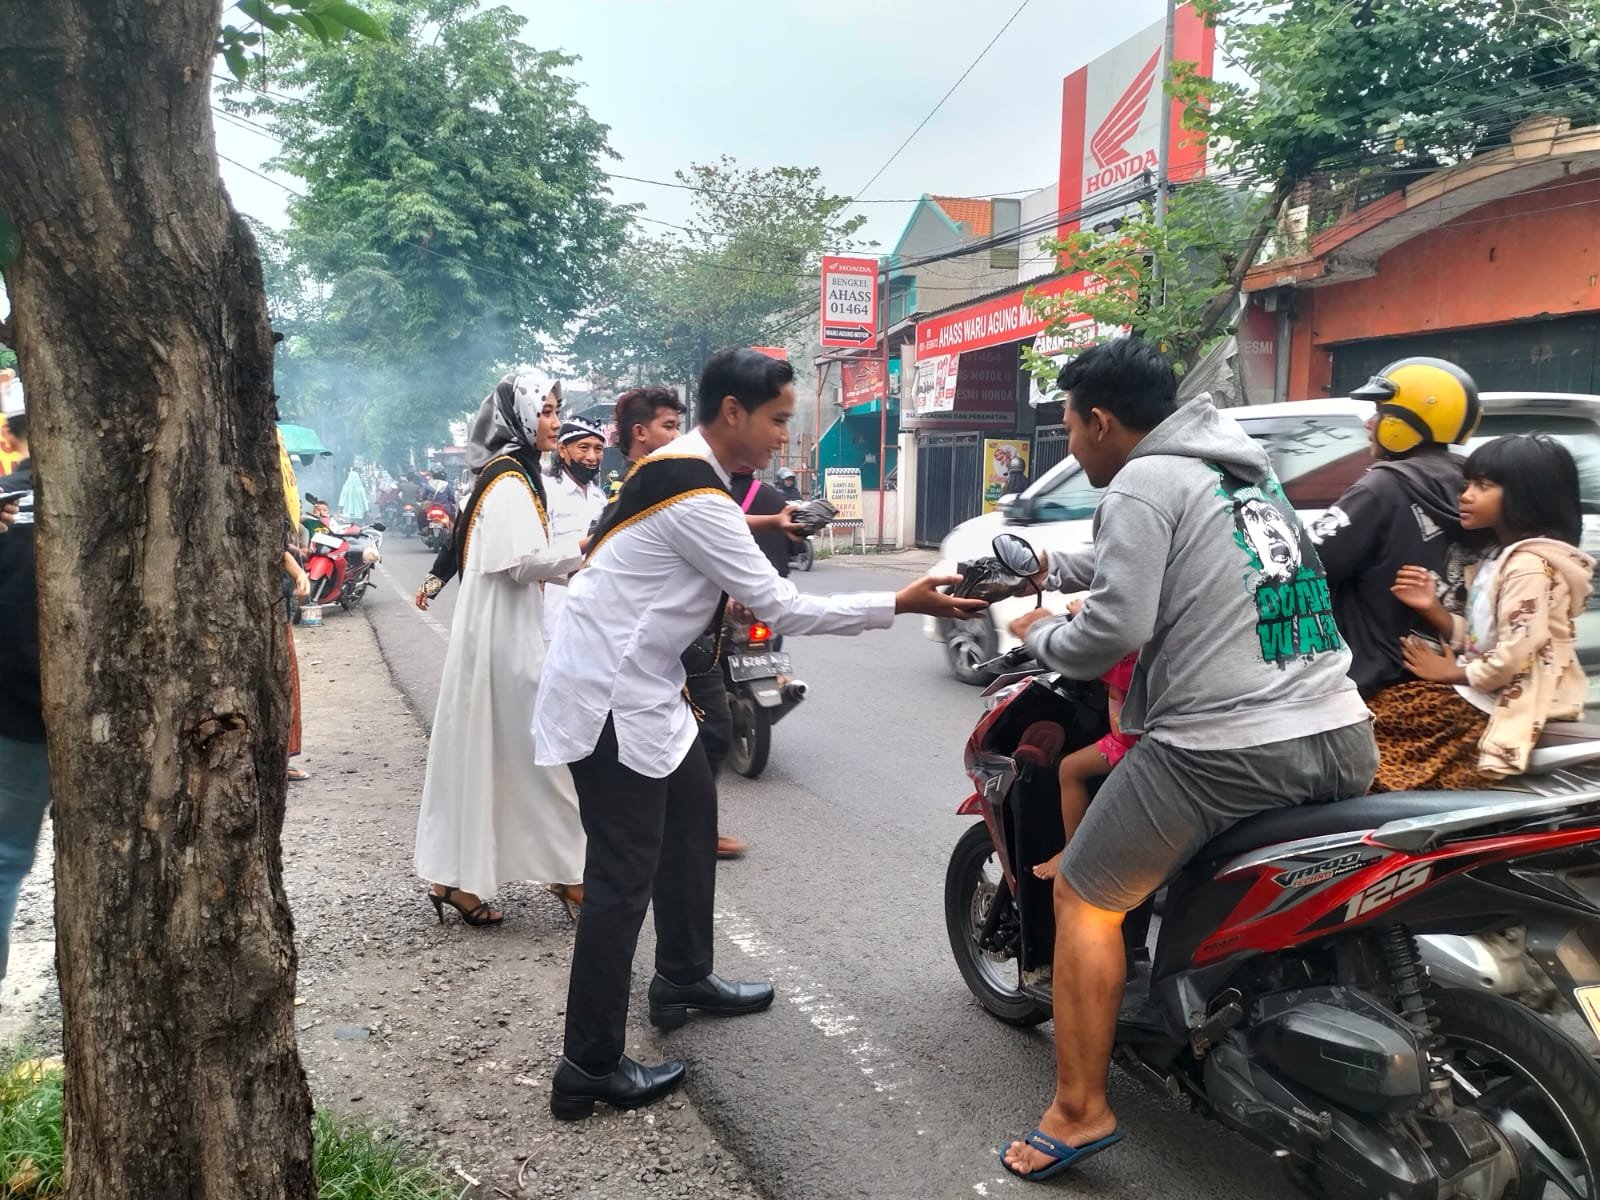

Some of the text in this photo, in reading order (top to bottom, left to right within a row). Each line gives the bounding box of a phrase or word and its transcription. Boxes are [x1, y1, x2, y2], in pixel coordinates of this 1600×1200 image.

[1086, 149, 1159, 195] HONDA
[838, 265, 872, 273] HONDA
[832, 277, 869, 288] BENGKEL
[829, 289, 871, 303] AHASS
[830, 302, 868, 315] 01464
[939, 322, 963, 348] AHASS
[964, 315, 987, 342] WARU
[988, 305, 1018, 337] AGUNG
[984, 773, 1005, 797] FI
[1344, 860, 1435, 923] 125
